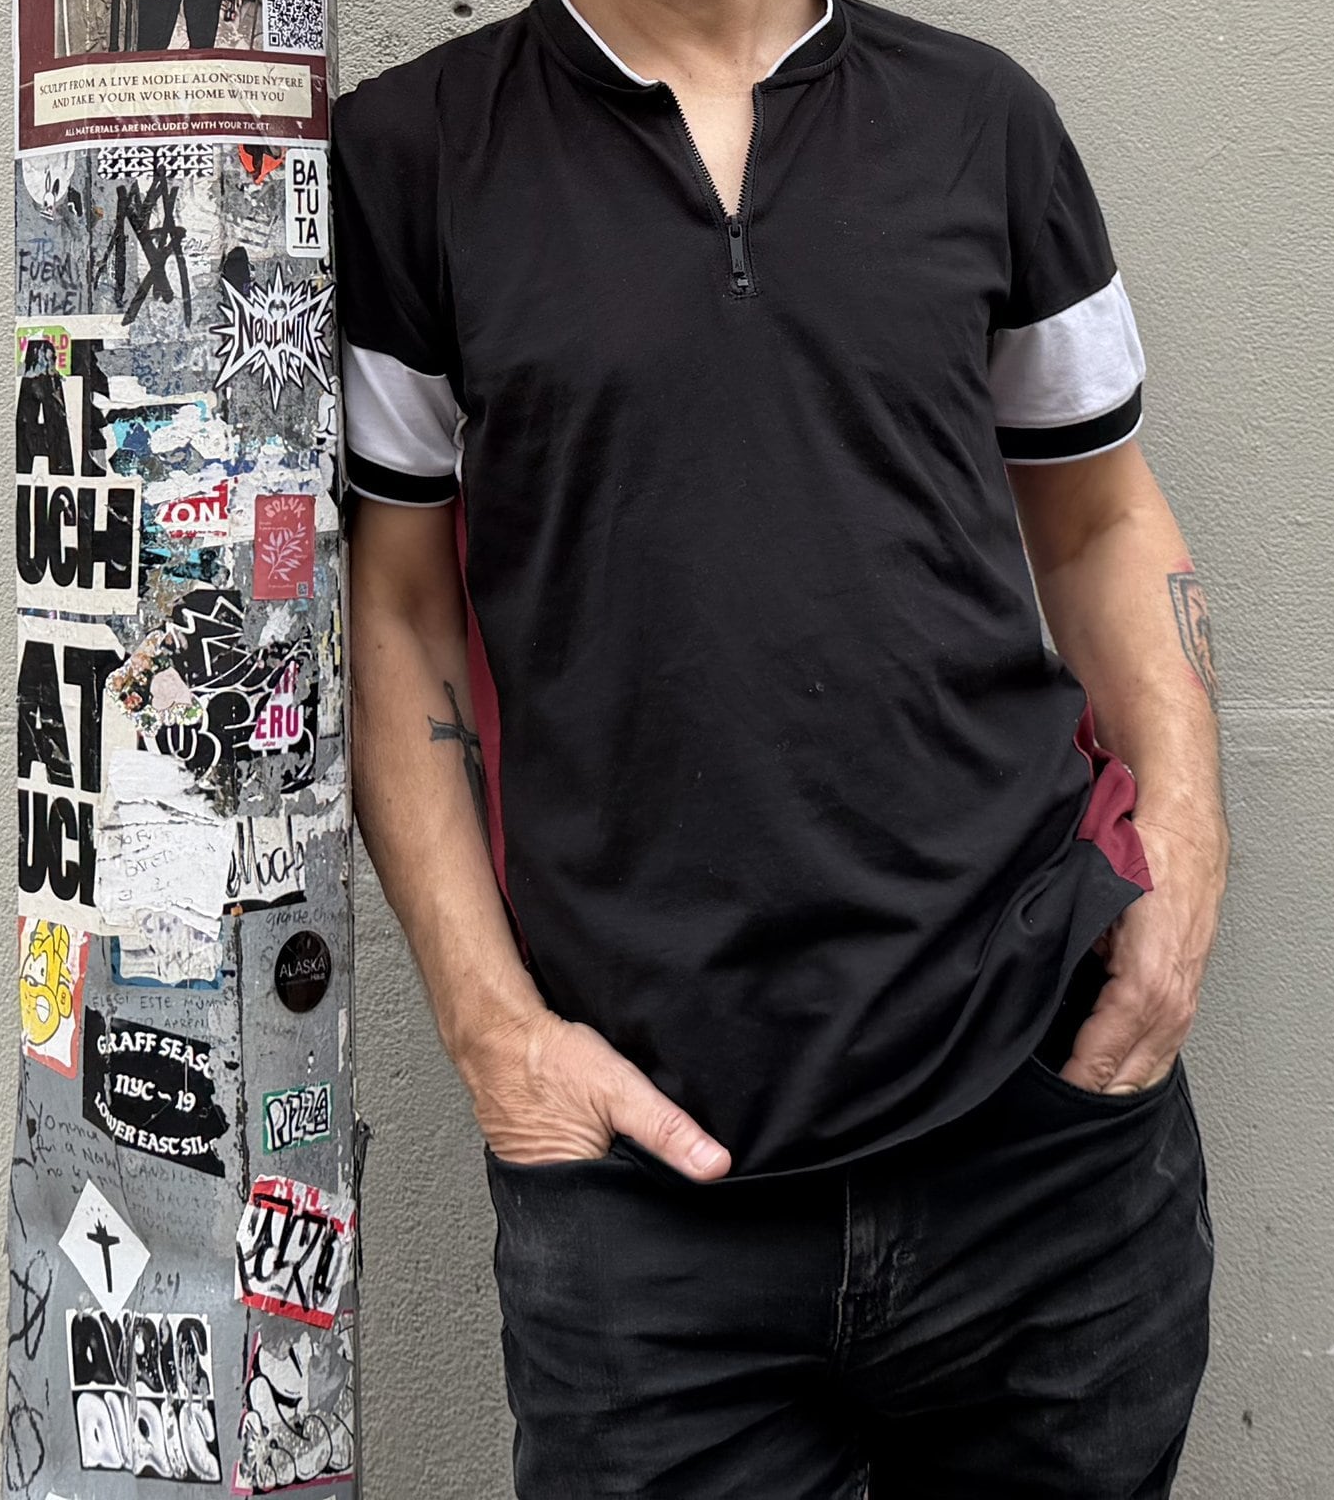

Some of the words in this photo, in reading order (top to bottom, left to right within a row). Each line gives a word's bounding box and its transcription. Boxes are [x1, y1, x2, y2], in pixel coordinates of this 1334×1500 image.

[40, 81, 68, 95] SCULPT
[69, 78, 96, 91] FROM
[98, 77, 108, 88] A
[111, 75, 139, 87] LIVE
[142, 74, 189, 85] MODEL
[52, 97, 68, 109] AND
[71, 94, 95, 106] TAKE
[98, 91, 138, 103] YOUR
[140, 90, 181, 102] WORK
[184, 89, 225, 100] HOME
[228, 89, 258, 101] WITH
[260, 90, 286, 102] YOU
[75, 124, 120, 136] MATERIALS
[121, 123, 139, 133] ARE
[140, 121, 190, 132] INCLUDED
[190, 120, 217, 131] WITH
[218, 120, 242, 130] YOUR
[292, 158, 318, 185] BA
[293, 187, 318, 215] TU
[294, 217, 318, 244] TA
[17, 484, 134, 590] UCH
[279, 957, 327, 978] ALASKA
[97, 1031, 158, 1056] GRAFF
[114, 1073, 156, 1101] NYC
[175, 1090, 197, 1112] 19
[94, 1091, 137, 1144] LOWER
[137, 1128, 180, 1156] EAST
